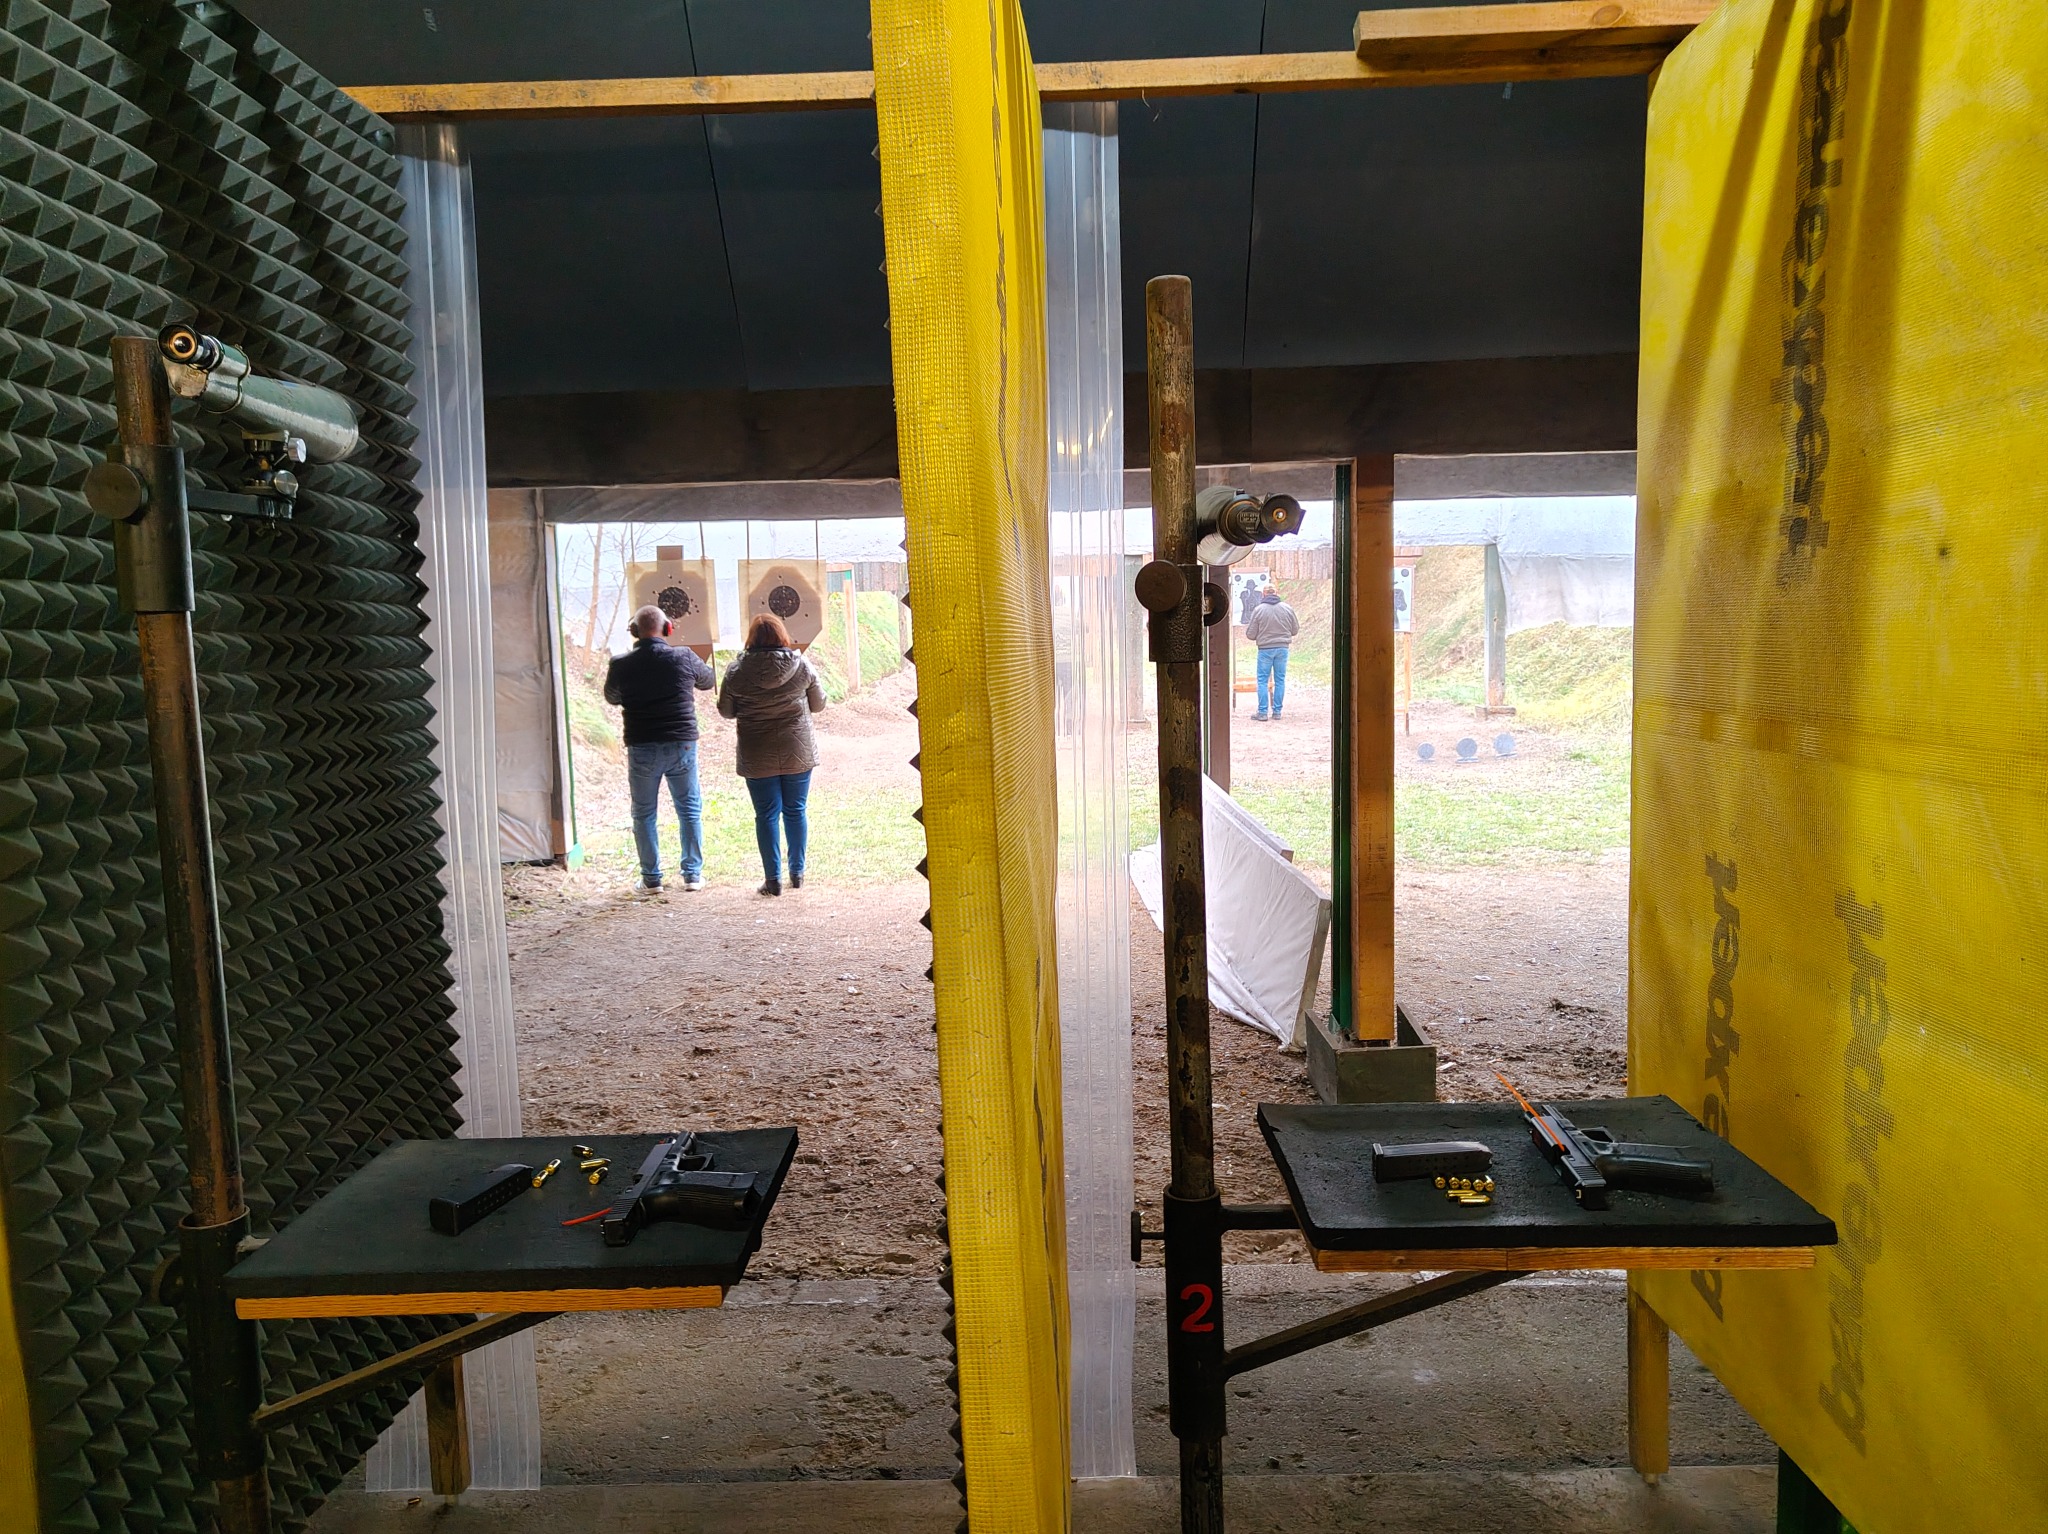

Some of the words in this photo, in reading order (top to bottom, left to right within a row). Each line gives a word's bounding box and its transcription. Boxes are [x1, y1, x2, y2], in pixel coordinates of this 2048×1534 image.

[1180, 1284, 1215, 1333] 2
[1691, 851, 1739, 1322] bexpert
[1819, 887, 1894, 1457] bauexpert
